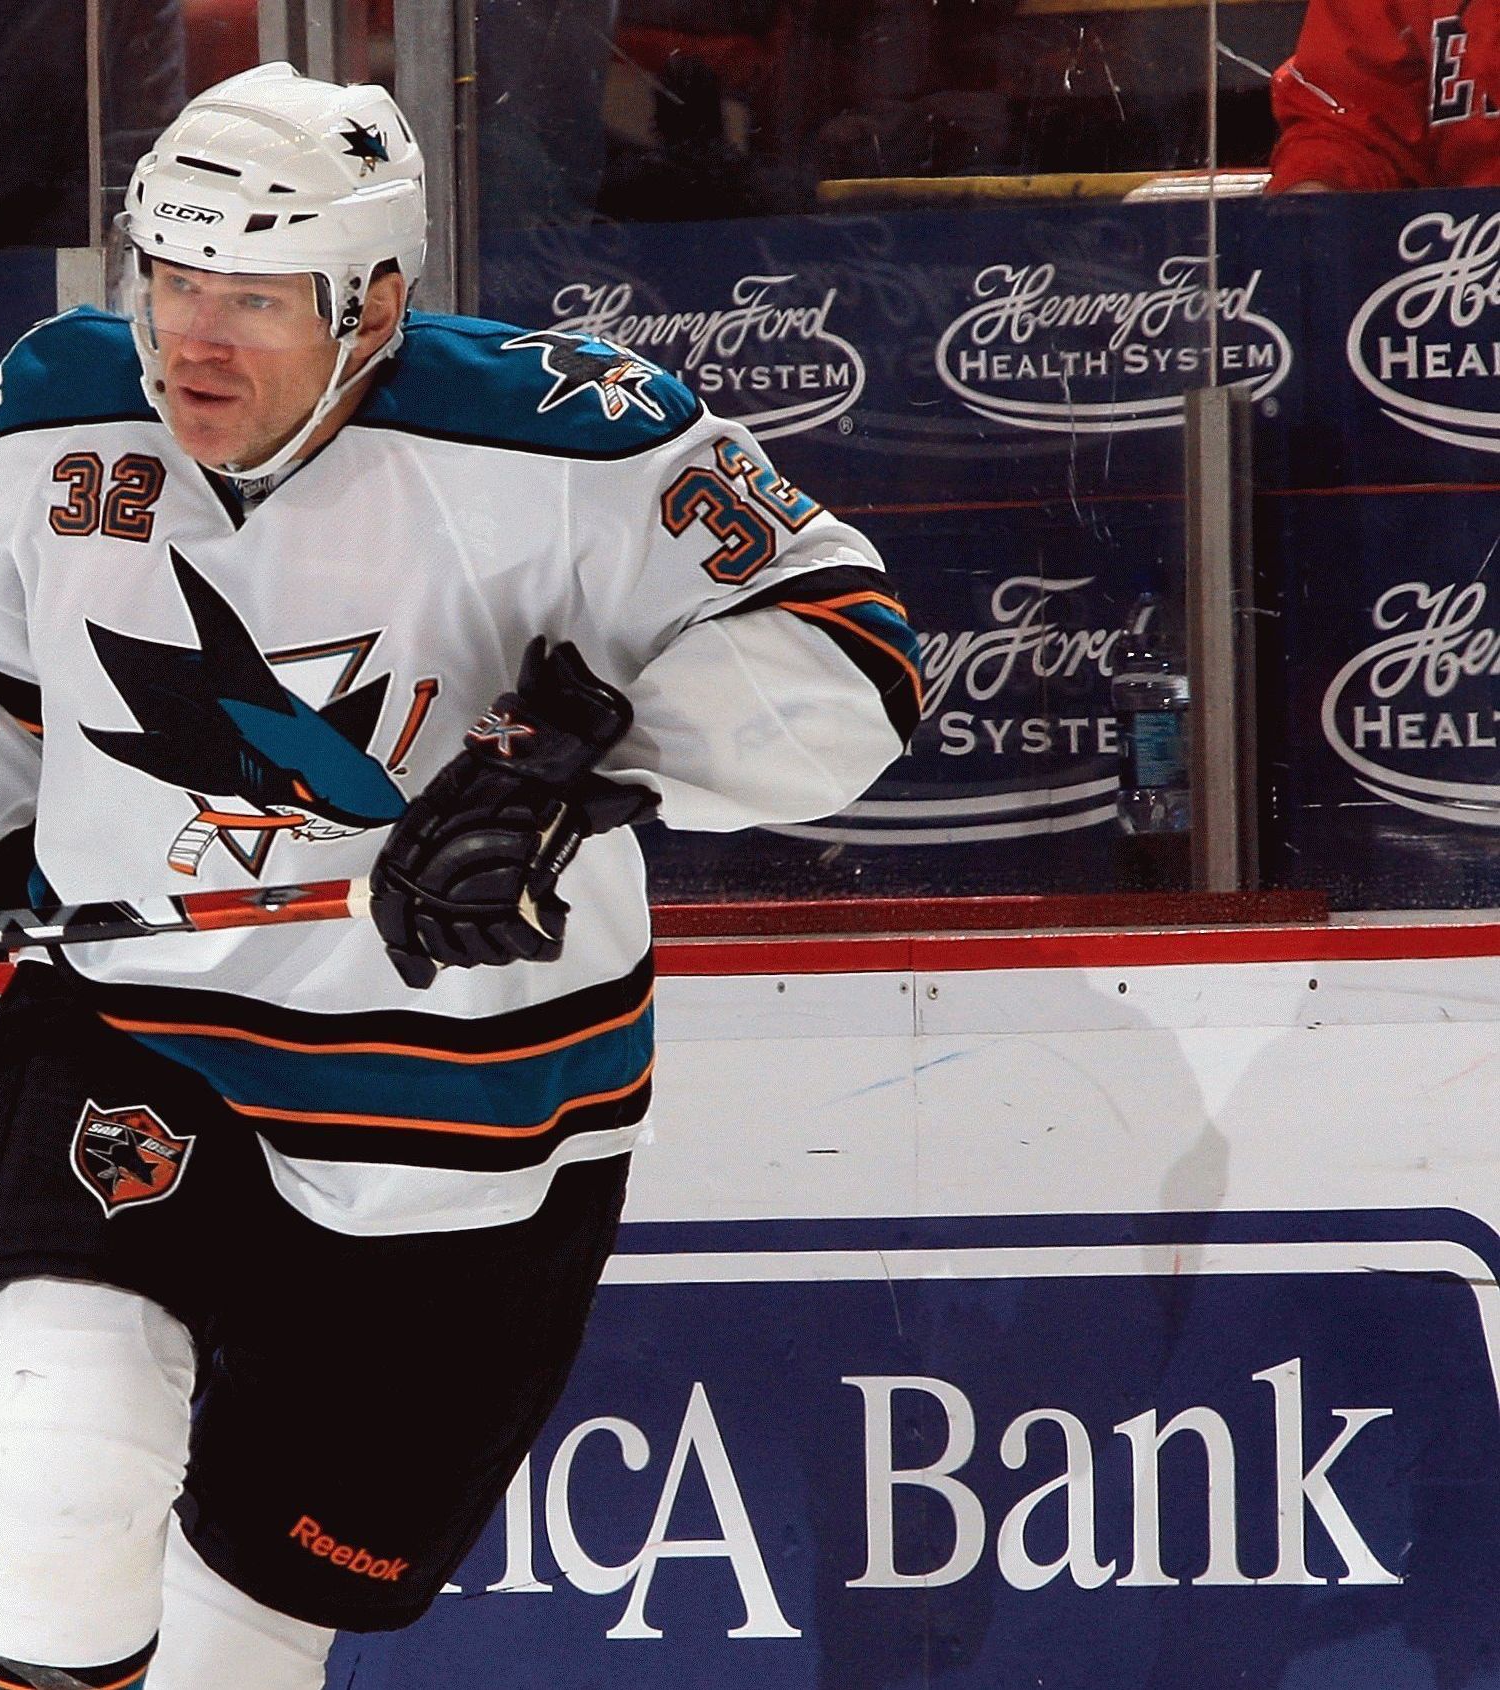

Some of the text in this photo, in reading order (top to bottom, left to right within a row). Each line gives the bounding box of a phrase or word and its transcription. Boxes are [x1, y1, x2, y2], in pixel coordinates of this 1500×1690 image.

[160, 203, 215, 224] CCM
[552, 274, 838, 370] Henry Ford
[972, 263, 1152, 350] Henry
[700, 363, 849, 391] SYSTEM
[959, 349, 1107, 381] HEALTH
[1378, 335, 1500, 380] HEA
[48, 451, 167, 543] 32
[660, 436, 822, 587] 32
[940, 711, 1124, 756] SYSTE
[1353, 705, 1500, 749] HEAL
[841, 1357, 1405, 1591] Bank
[289, 1514, 410, 1582] Reebok
